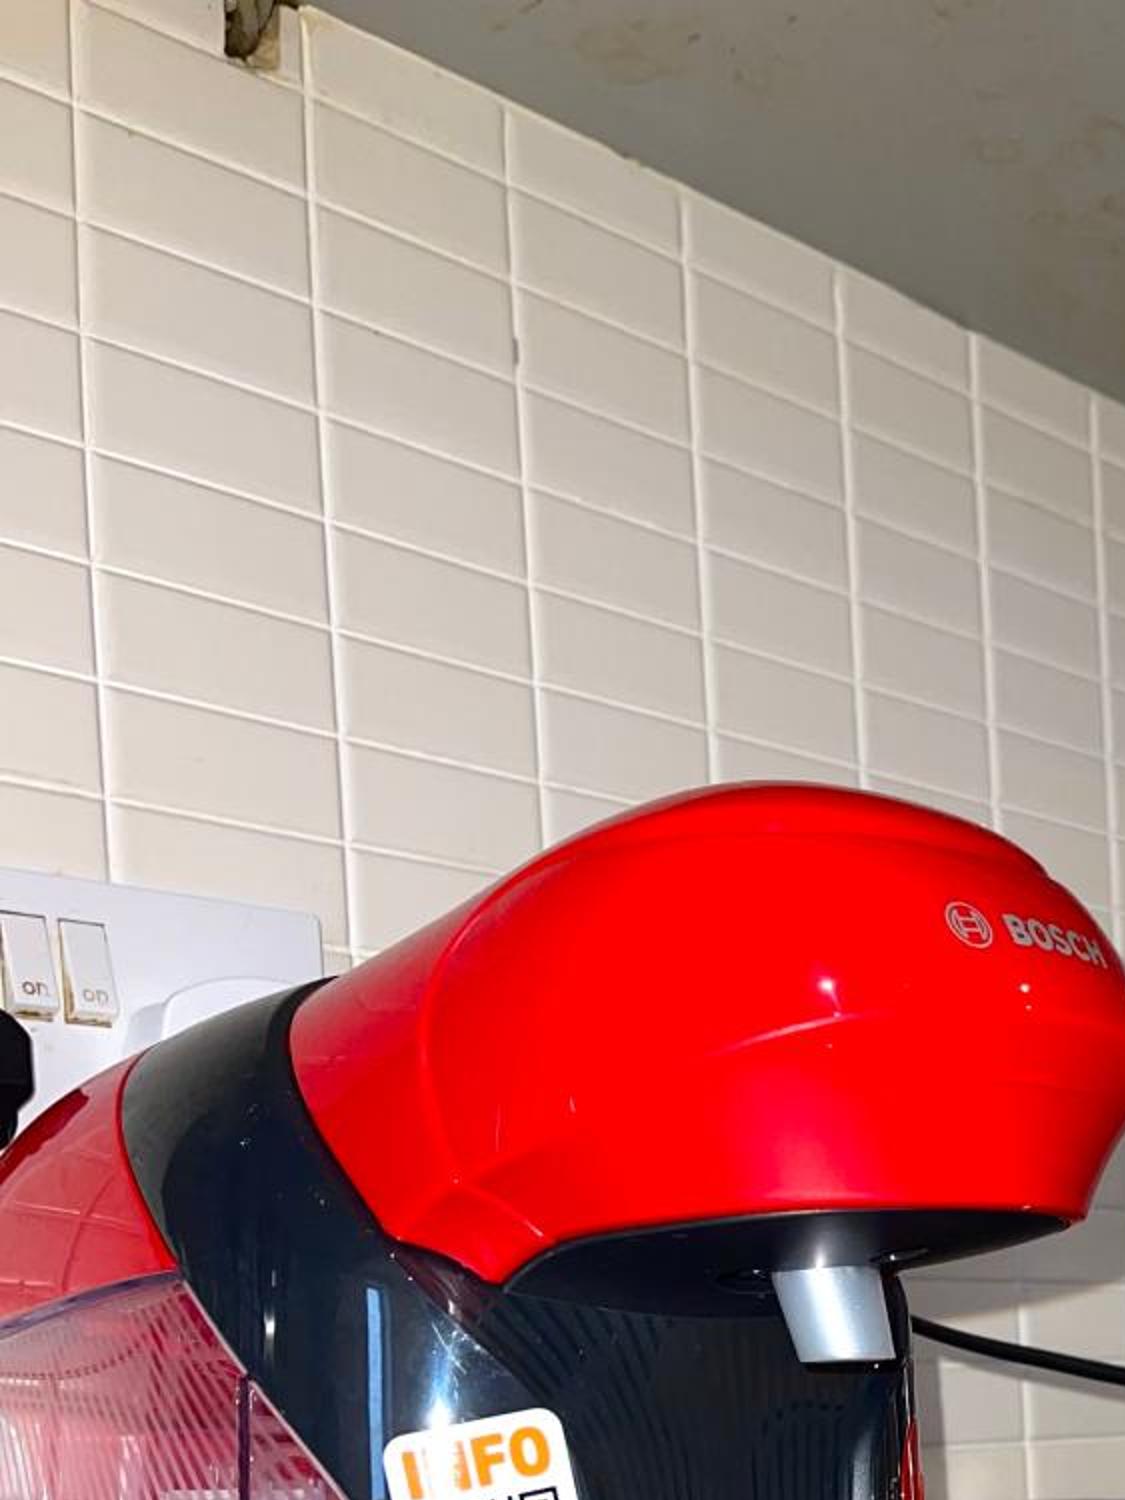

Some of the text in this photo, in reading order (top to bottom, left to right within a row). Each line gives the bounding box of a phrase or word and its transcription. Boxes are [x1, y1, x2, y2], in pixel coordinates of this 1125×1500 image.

[1002, 914, 1108, 969] BOSCH
[22, 981, 49, 997] on
[83, 988, 109, 1005] on
